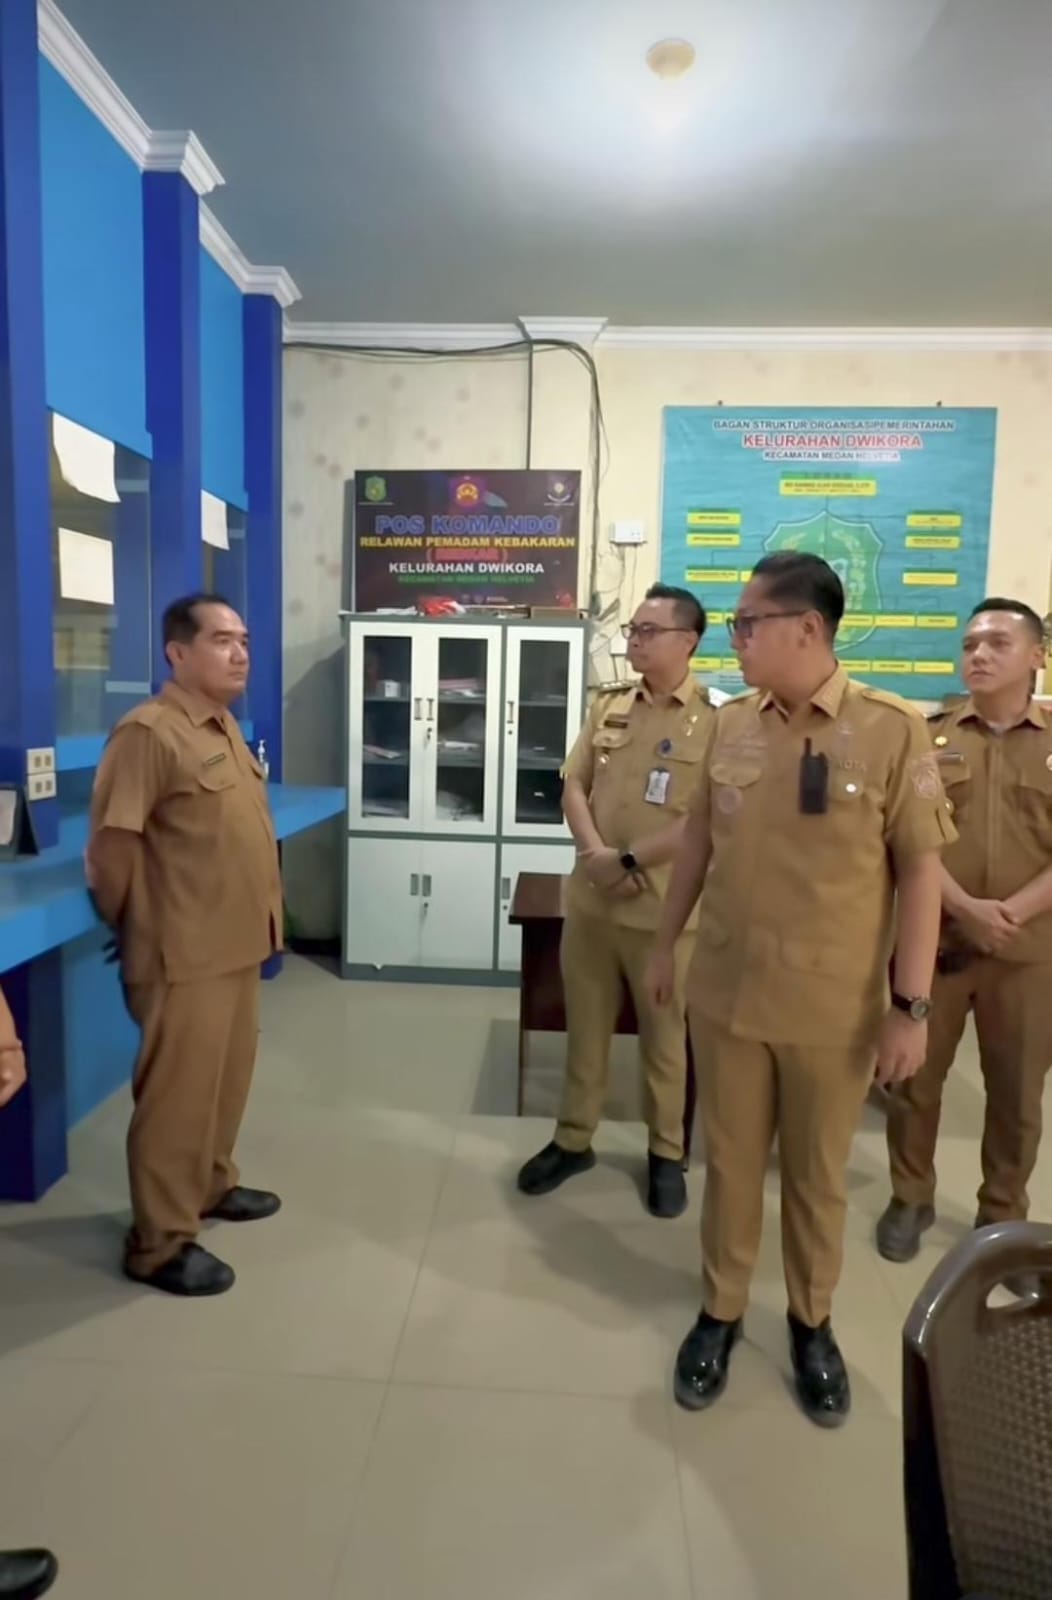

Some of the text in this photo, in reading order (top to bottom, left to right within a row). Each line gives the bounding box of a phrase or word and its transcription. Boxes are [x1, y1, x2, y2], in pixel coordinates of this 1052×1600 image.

[713, 420, 750, 430] BAGAN
[752, 420, 807, 430] STRUKTUR
[743, 434, 921, 447] KELURAHAN DWIKORA
[764, 451, 819, 459] KECAMATAN
[821, 451, 854, 459] MEDAN
[375, 514, 562, 535] POS KOMANDO
[360, 536, 576, 547] RELAWAN PEMADAM KEBAKARAN
[388, 562, 545, 573] KELURAHAN DWIKORA
